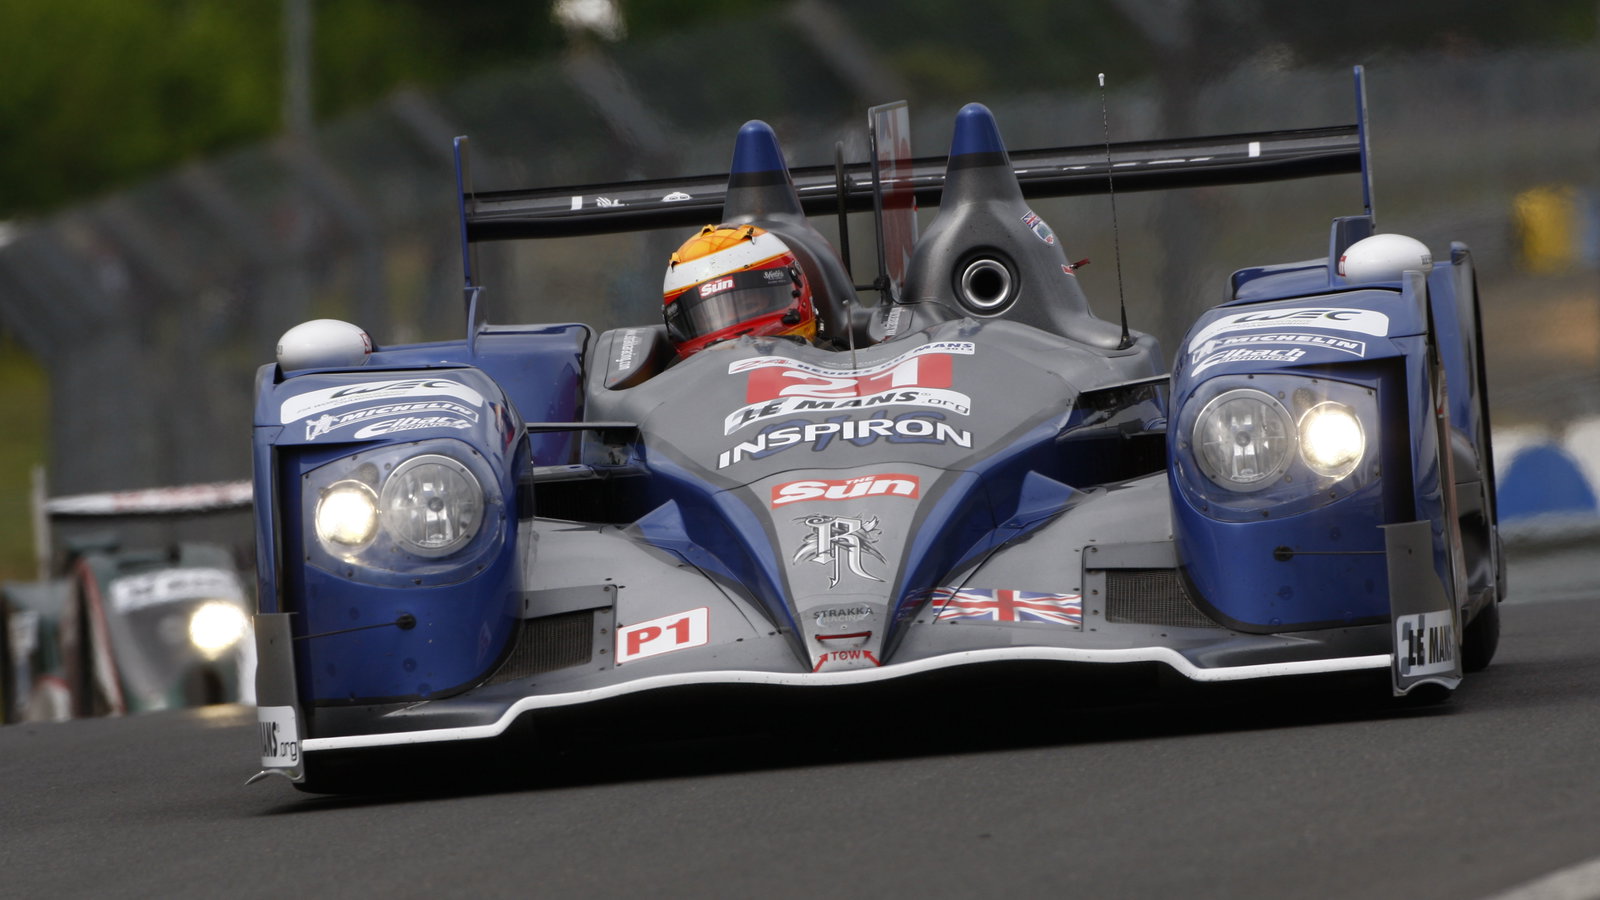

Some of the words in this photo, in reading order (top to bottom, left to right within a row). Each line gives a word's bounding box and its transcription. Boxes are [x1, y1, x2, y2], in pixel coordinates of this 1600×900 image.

[700, 279, 733, 297] Sun
[913, 343, 973, 354] MANS
[1222, 334, 1360, 350] MICHELIN
[779, 357, 918, 396] 21
[340, 402, 473, 423] MICHELIN
[739, 401, 784, 425] LE
[795, 391, 921, 410] MANS
[717, 418, 973, 469] INSPIRON
[773, 478, 916, 504] Sun
[813, 607, 874, 619] STRAKKA
[626, 617, 690, 656] P1
[1429, 624, 1453, 664] MAN
[831, 650, 861, 661] TOW
